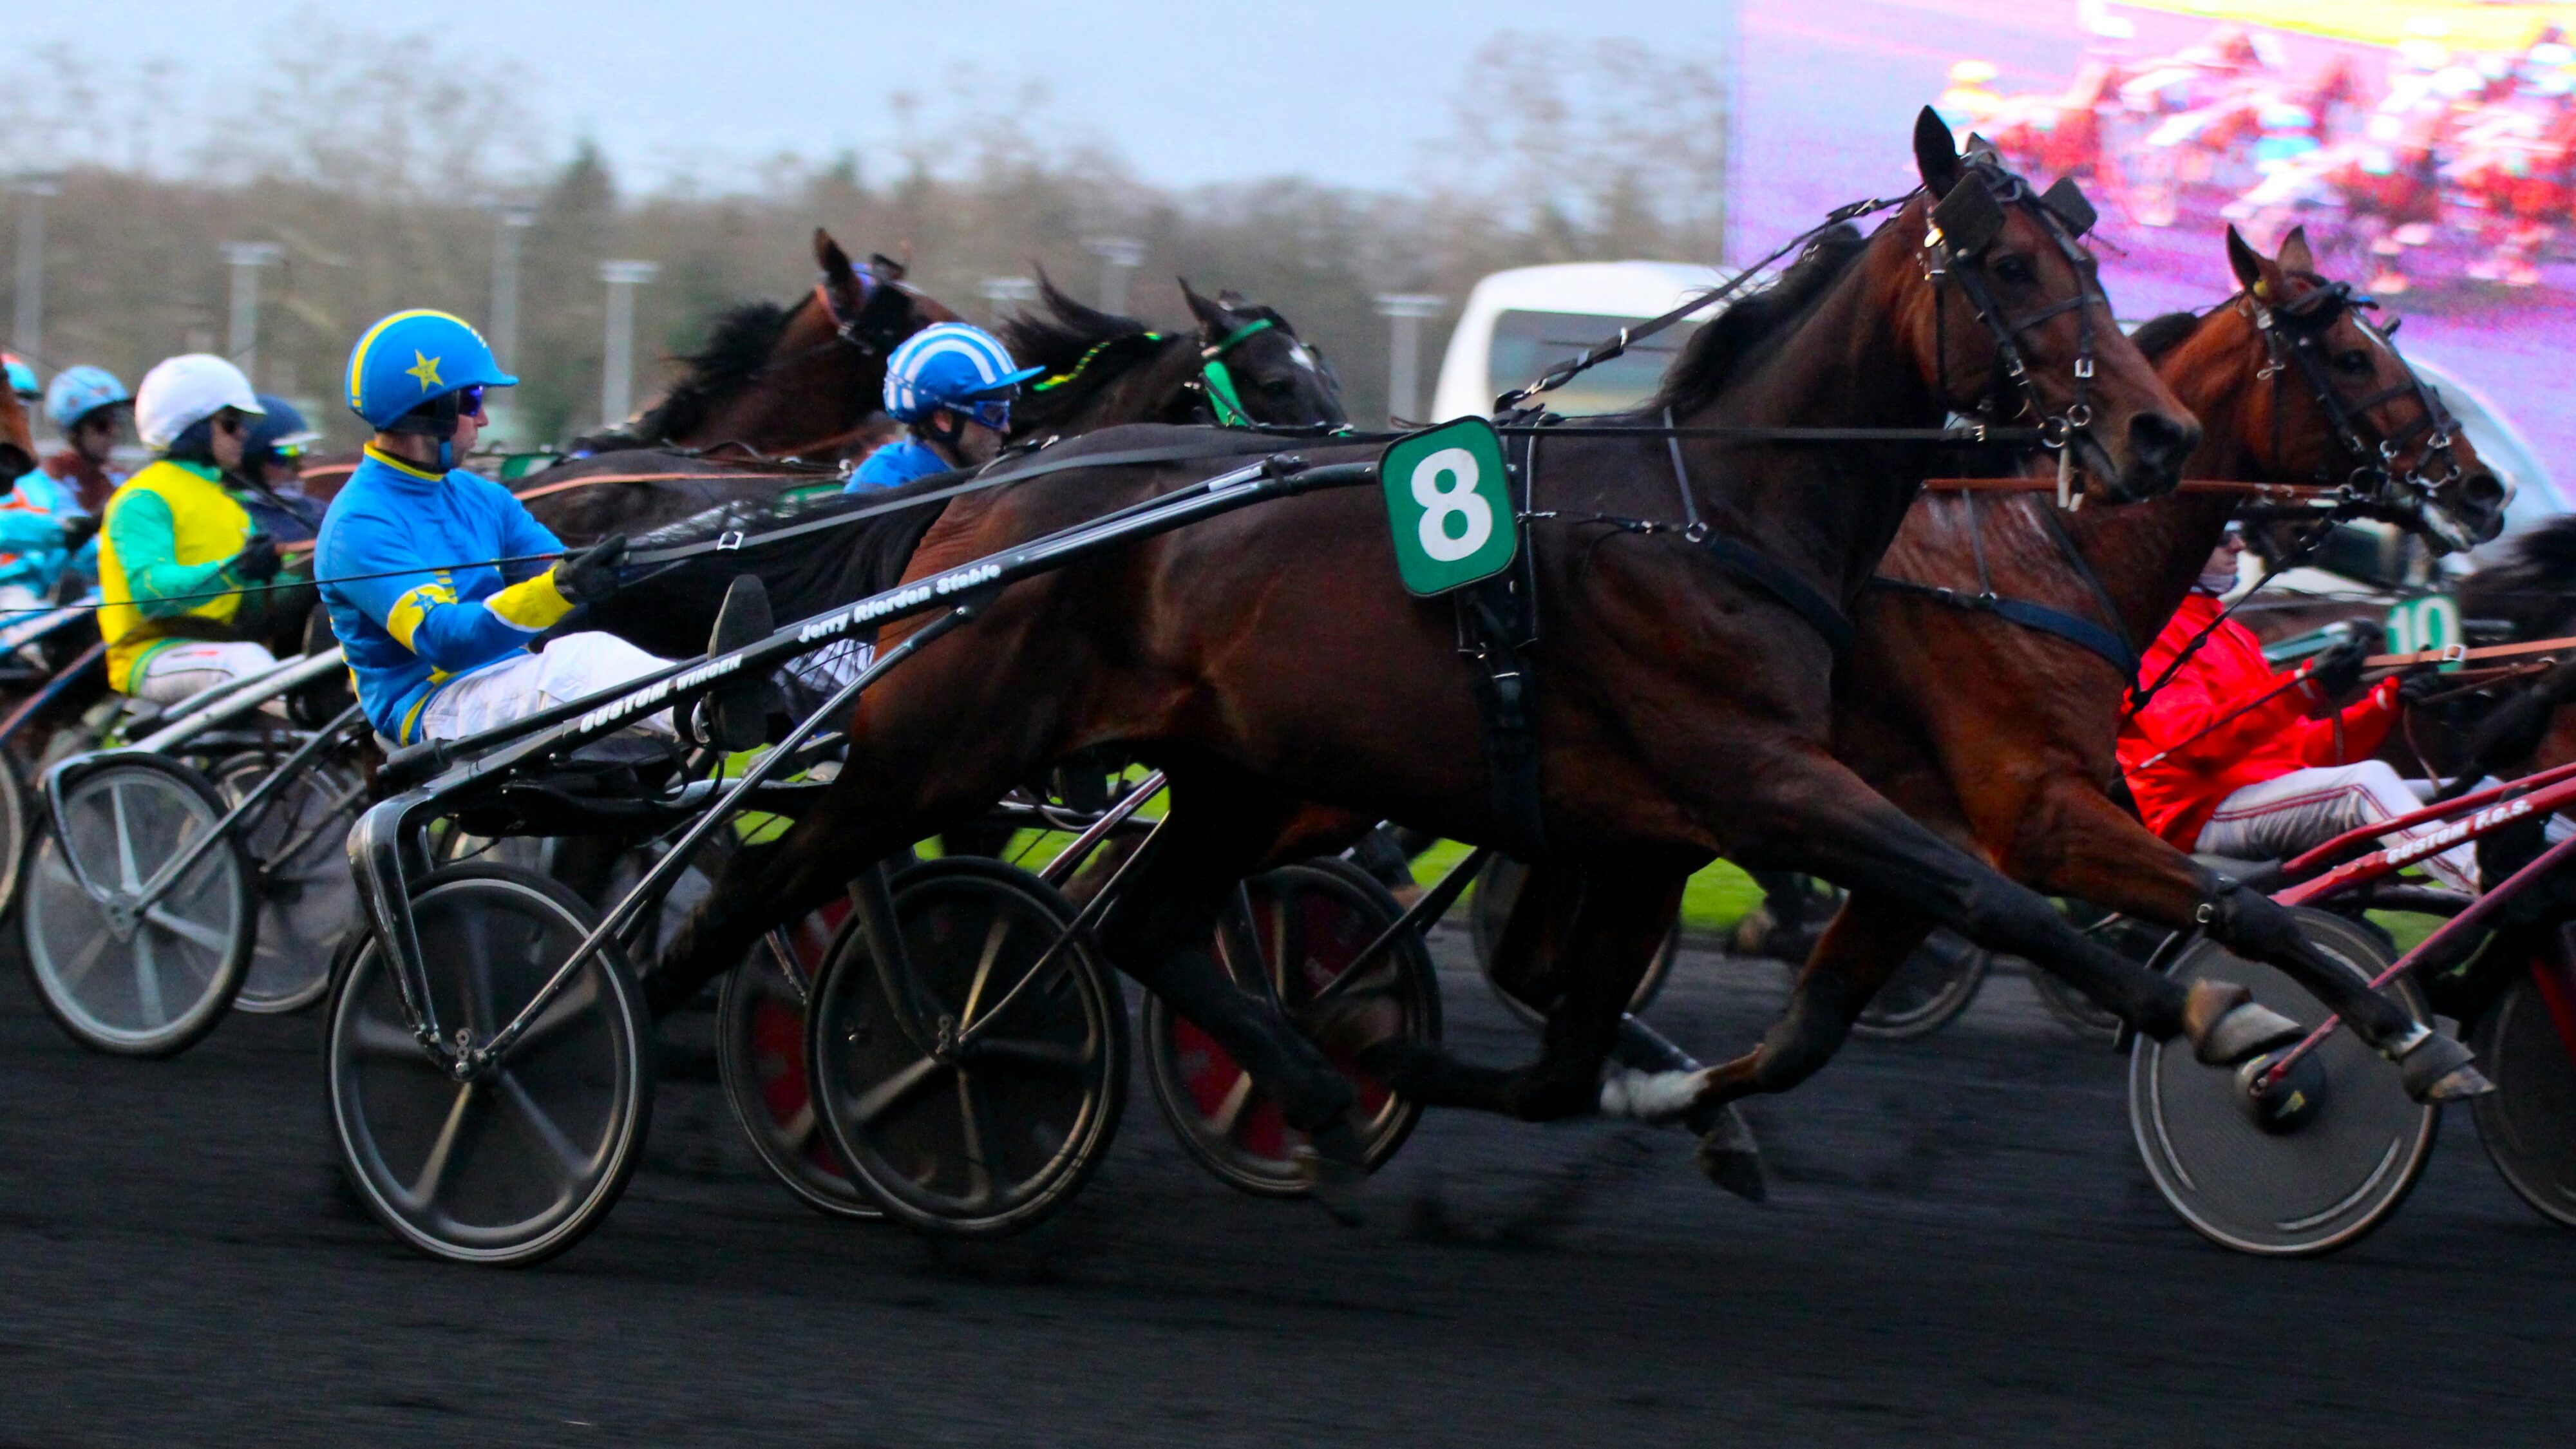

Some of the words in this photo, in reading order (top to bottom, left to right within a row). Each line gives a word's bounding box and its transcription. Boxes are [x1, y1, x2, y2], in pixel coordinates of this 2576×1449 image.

[1410, 448, 1493, 562] 8
[798, 613, 849, 643] Jerry
[853, 585, 931, 623] Riordan
[936, 564, 1001, 594] Stable
[2386, 598, 2460, 654] 10
[580, 679, 671, 734] CUSTOM
[2386, 821, 2469, 864] CUSTOM
